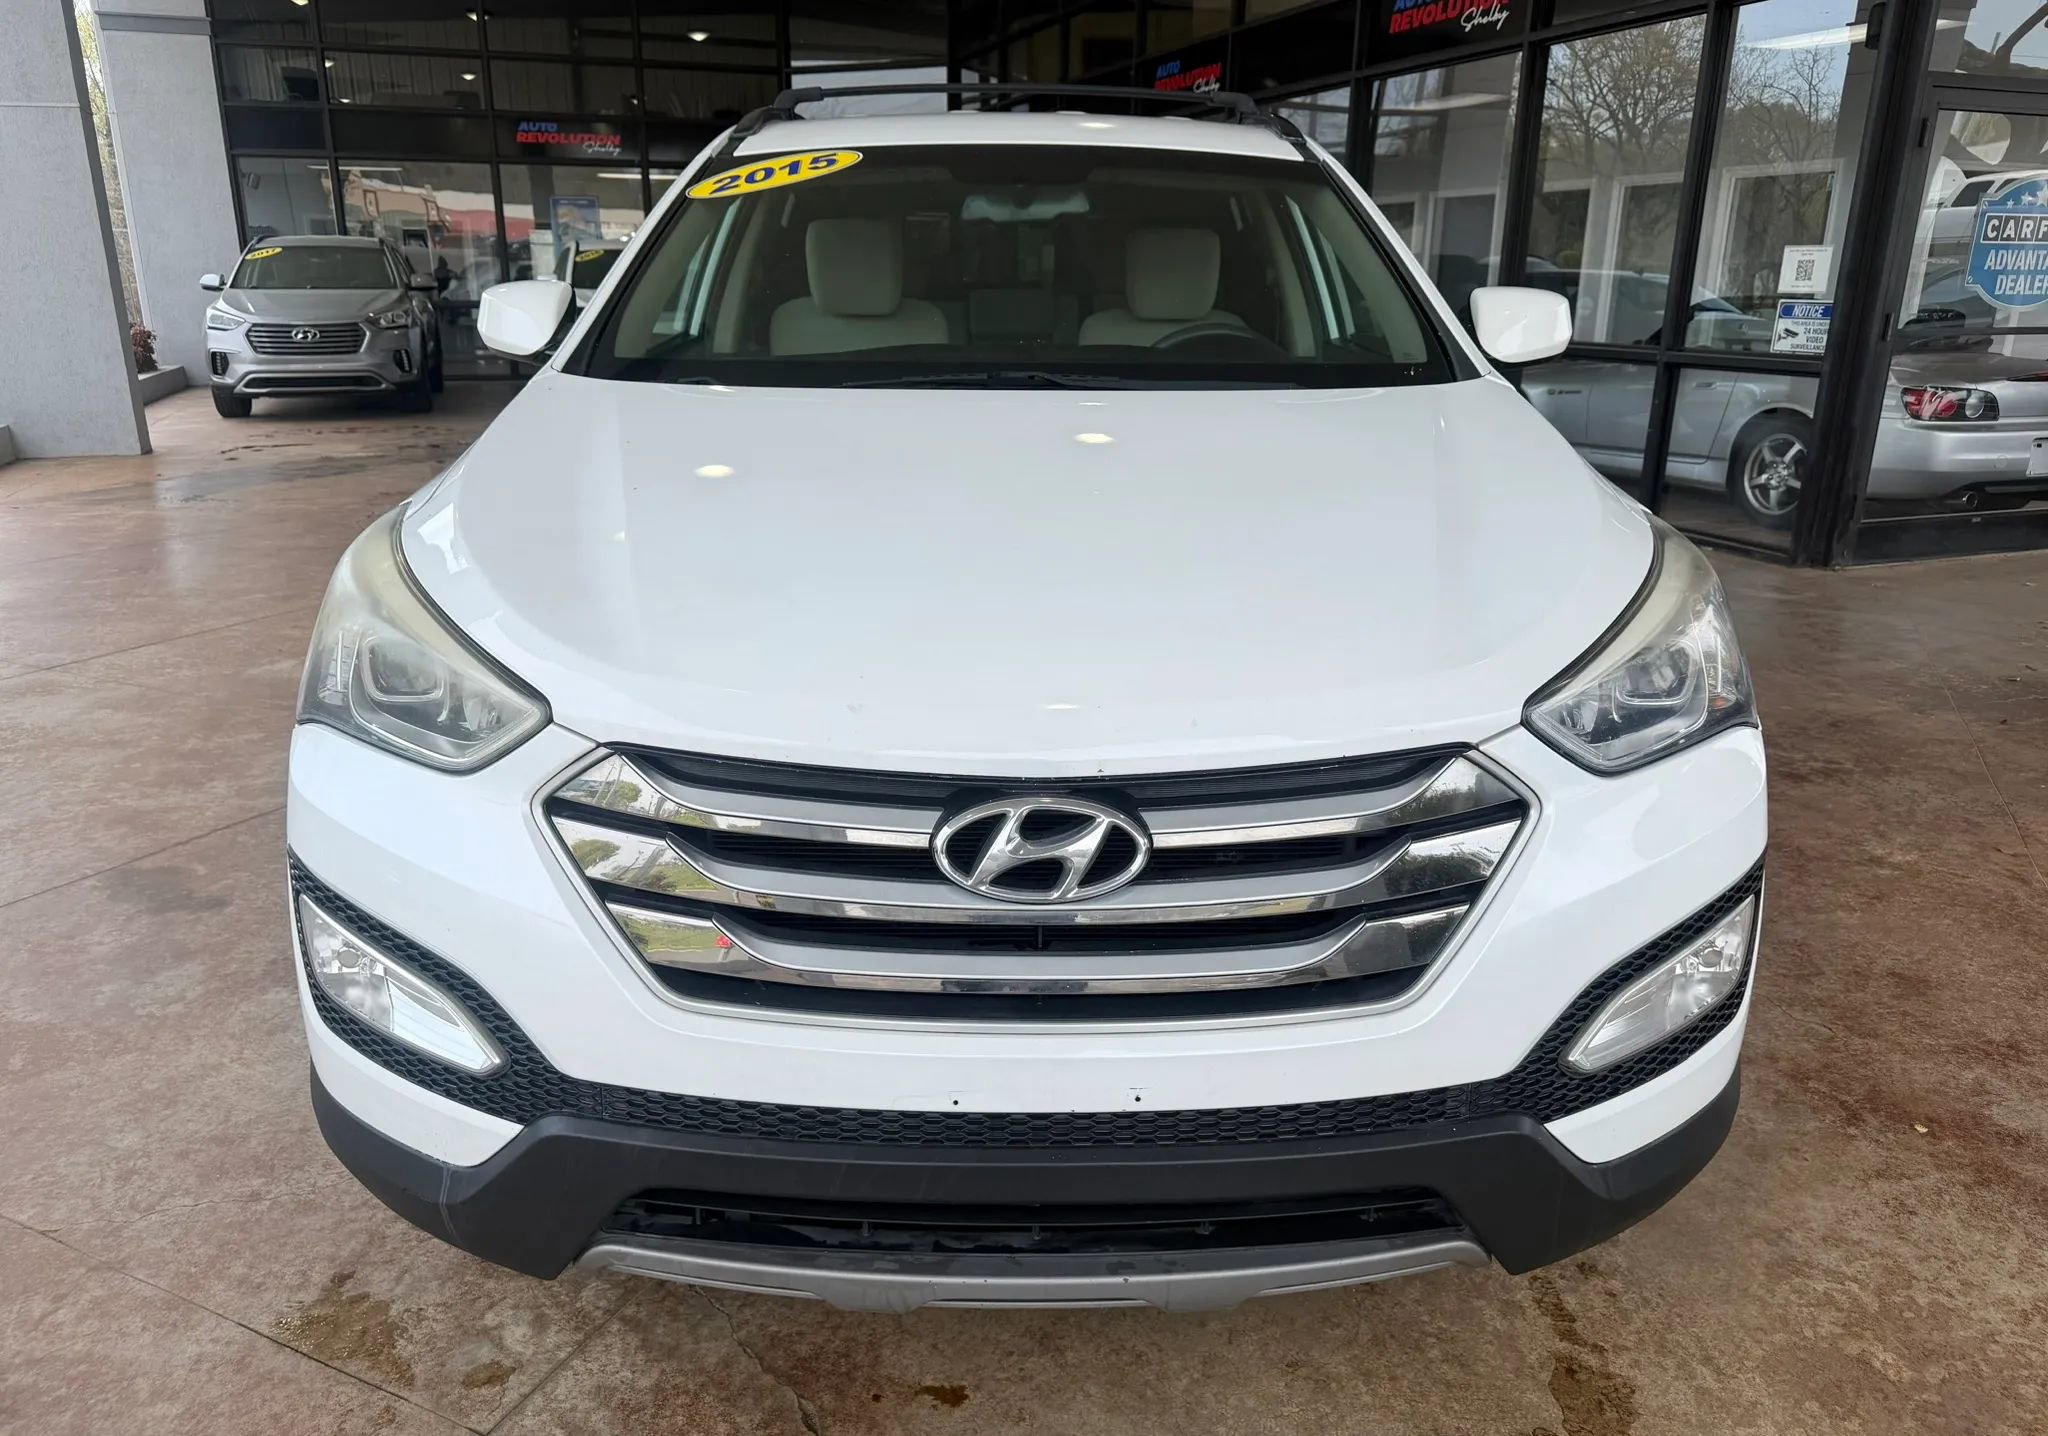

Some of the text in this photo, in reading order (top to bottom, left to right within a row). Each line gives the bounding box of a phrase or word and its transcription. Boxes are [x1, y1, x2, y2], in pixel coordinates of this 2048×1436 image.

[1460, 0, 1510, 32] Shelby
[518, 121, 558, 132] AUTO
[516, 132, 623, 145] REVOLUTION
[582, 141, 622, 156] Shelby
[709, 153, 839, 195] 2015
[1791, 305, 1825, 317] NOTICE
[1803, 327, 1811, 335] 24
[1805, 336, 1824, 344] VIDEO
